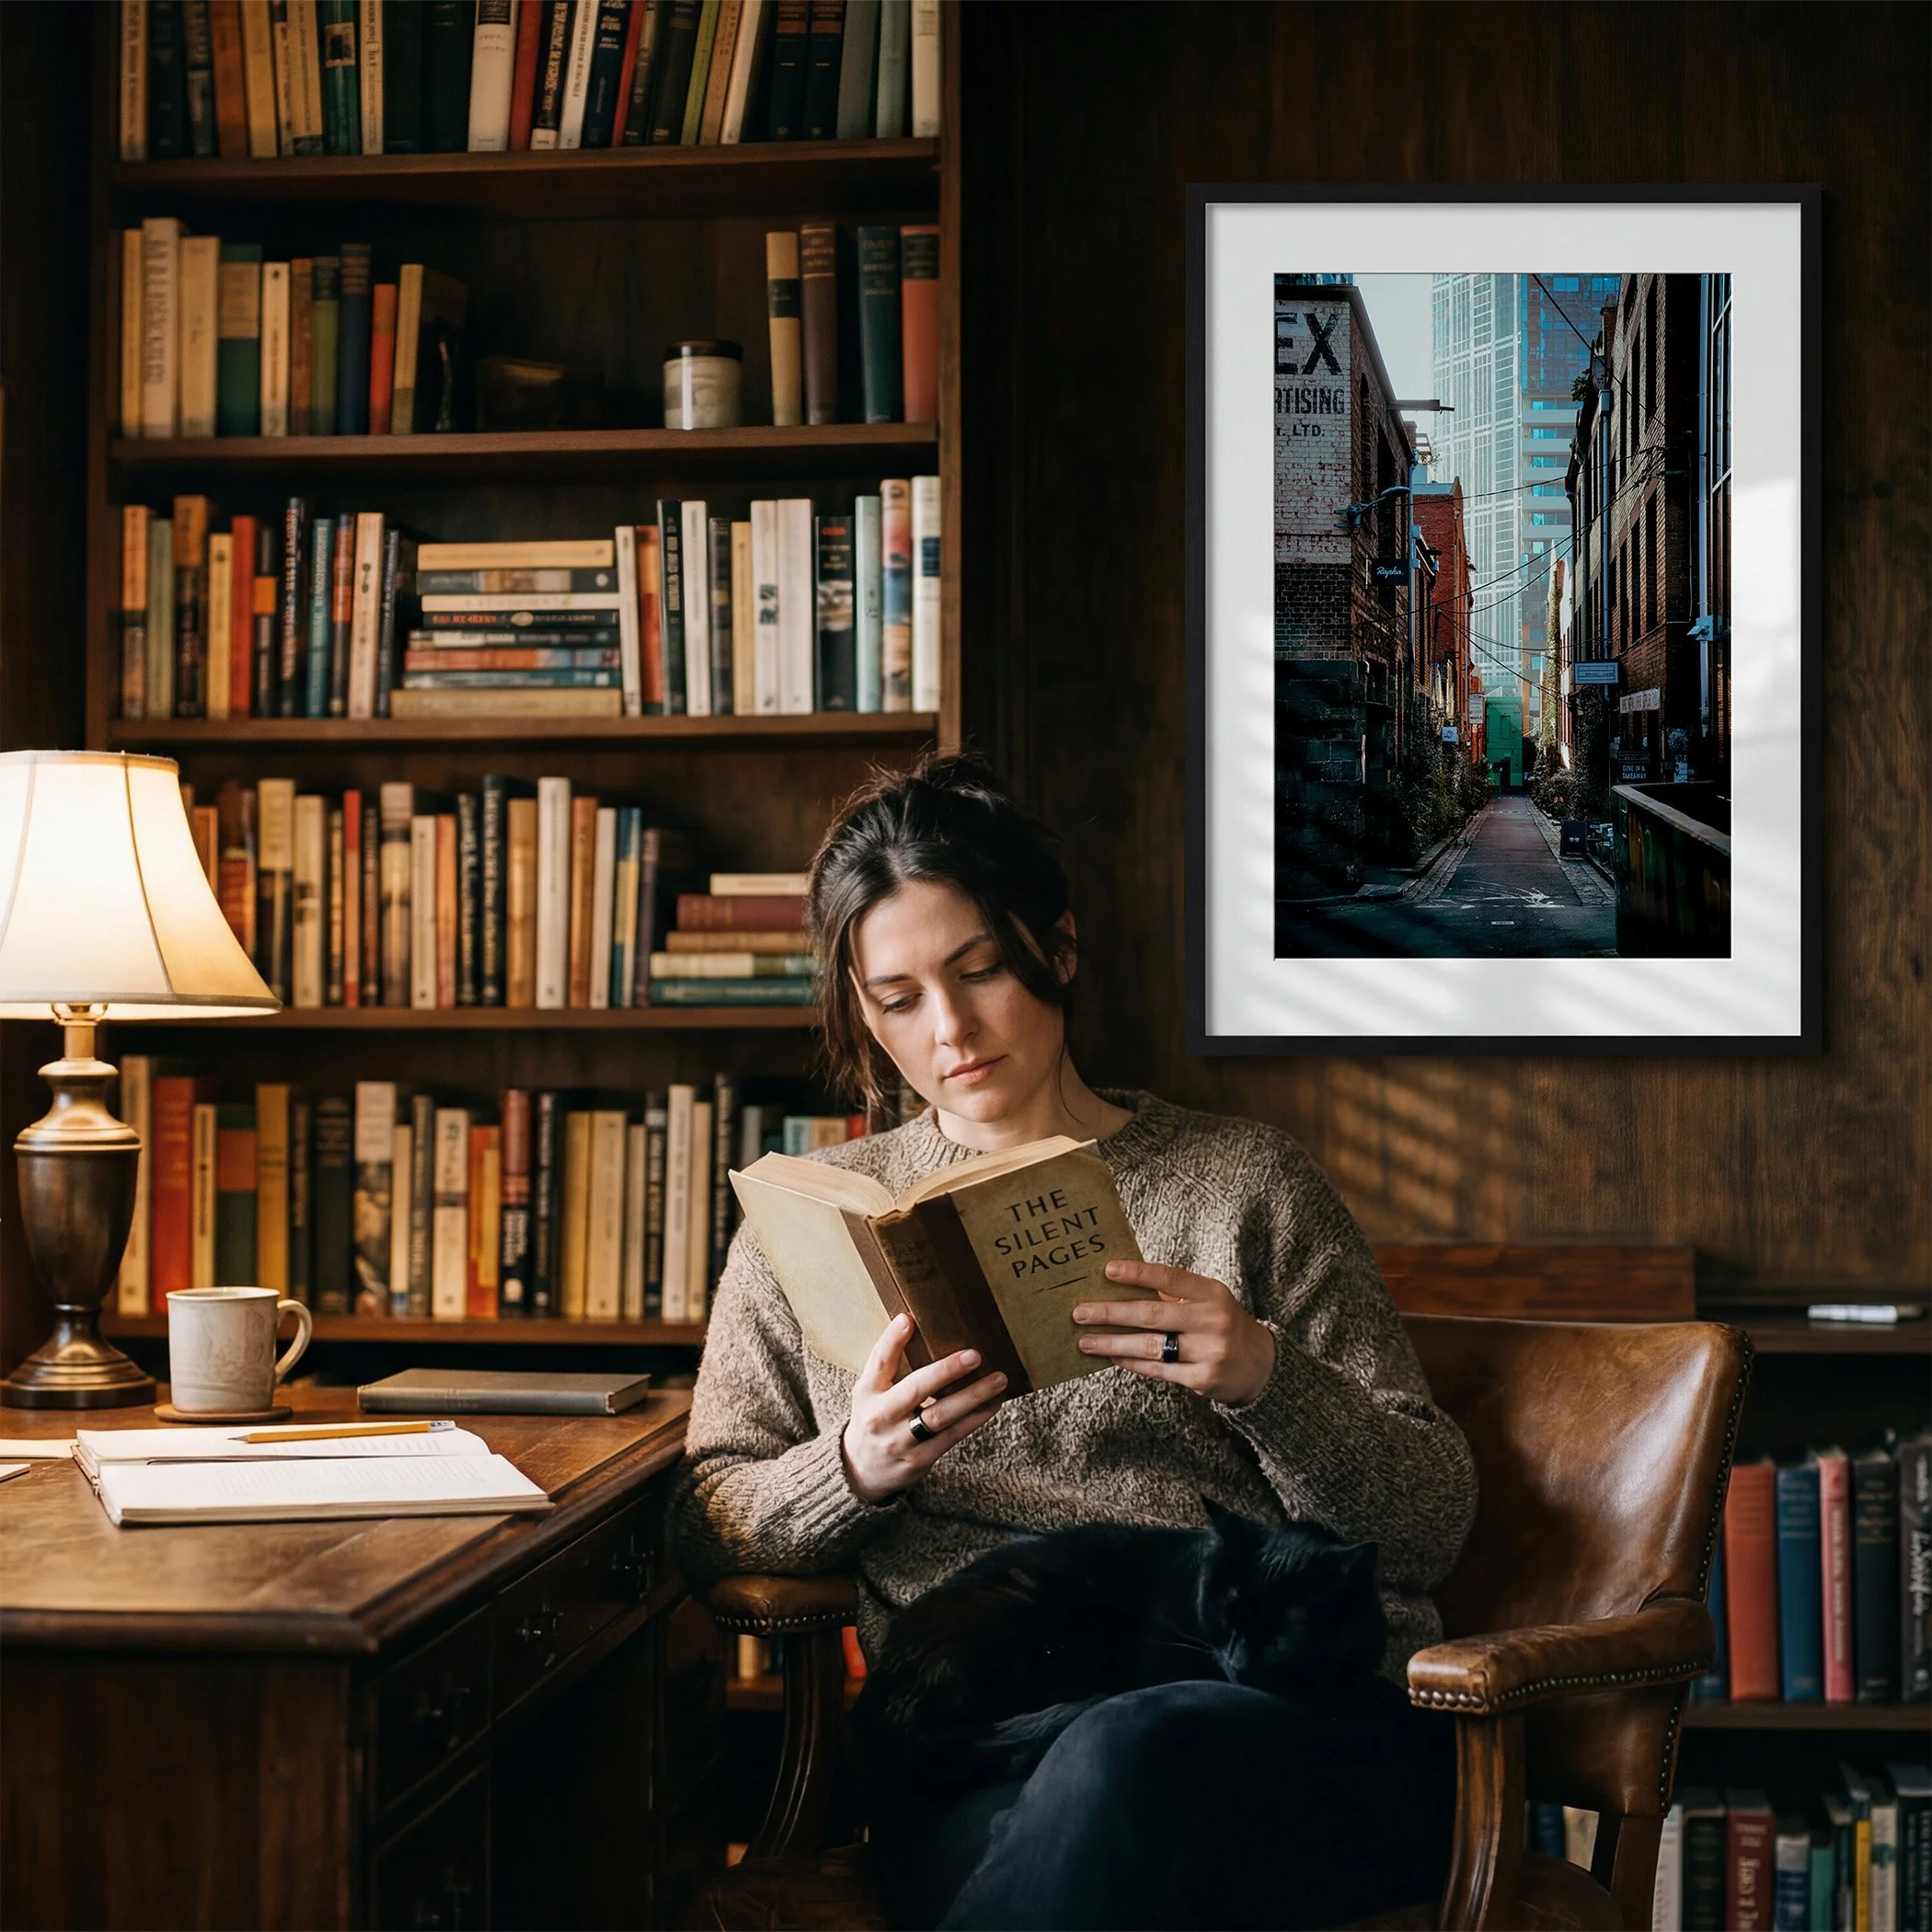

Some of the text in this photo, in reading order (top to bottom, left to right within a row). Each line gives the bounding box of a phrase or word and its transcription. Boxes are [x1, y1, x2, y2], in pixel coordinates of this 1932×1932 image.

[1275, 312, 1342, 375] EX
[1293, 424, 1325, 436] LTD.
[1005, 1189, 1068, 1223] THE
[995, 1206, 1098, 1255] SILENT
[1011, 1234, 1105, 1279] PAGES
